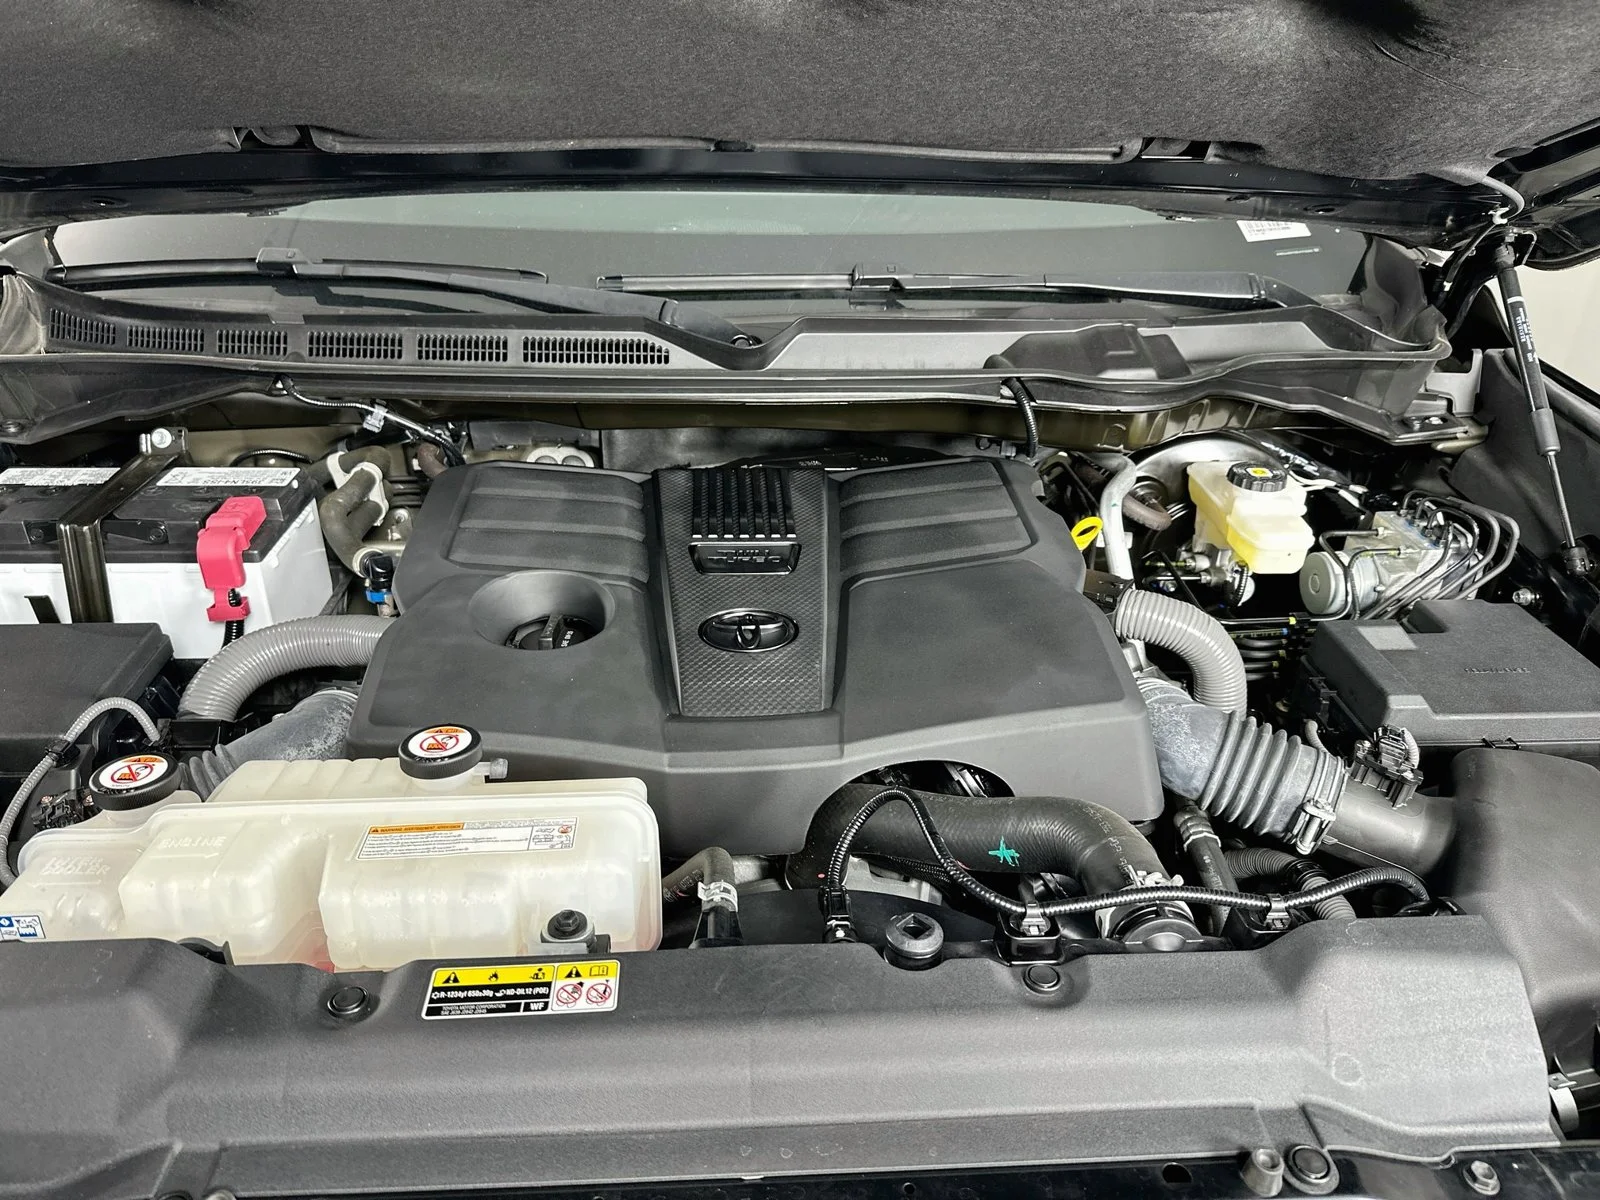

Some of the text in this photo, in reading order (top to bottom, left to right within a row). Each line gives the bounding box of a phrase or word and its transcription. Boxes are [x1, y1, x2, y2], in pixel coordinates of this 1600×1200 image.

[161, 836, 227, 849] ENGINE
[41, 864, 111, 875] COOLER
[439, 990, 467, 999] R-1234yf
[532, 986, 549, 995] (POE)
[530, 1002, 545, 1011] WF
